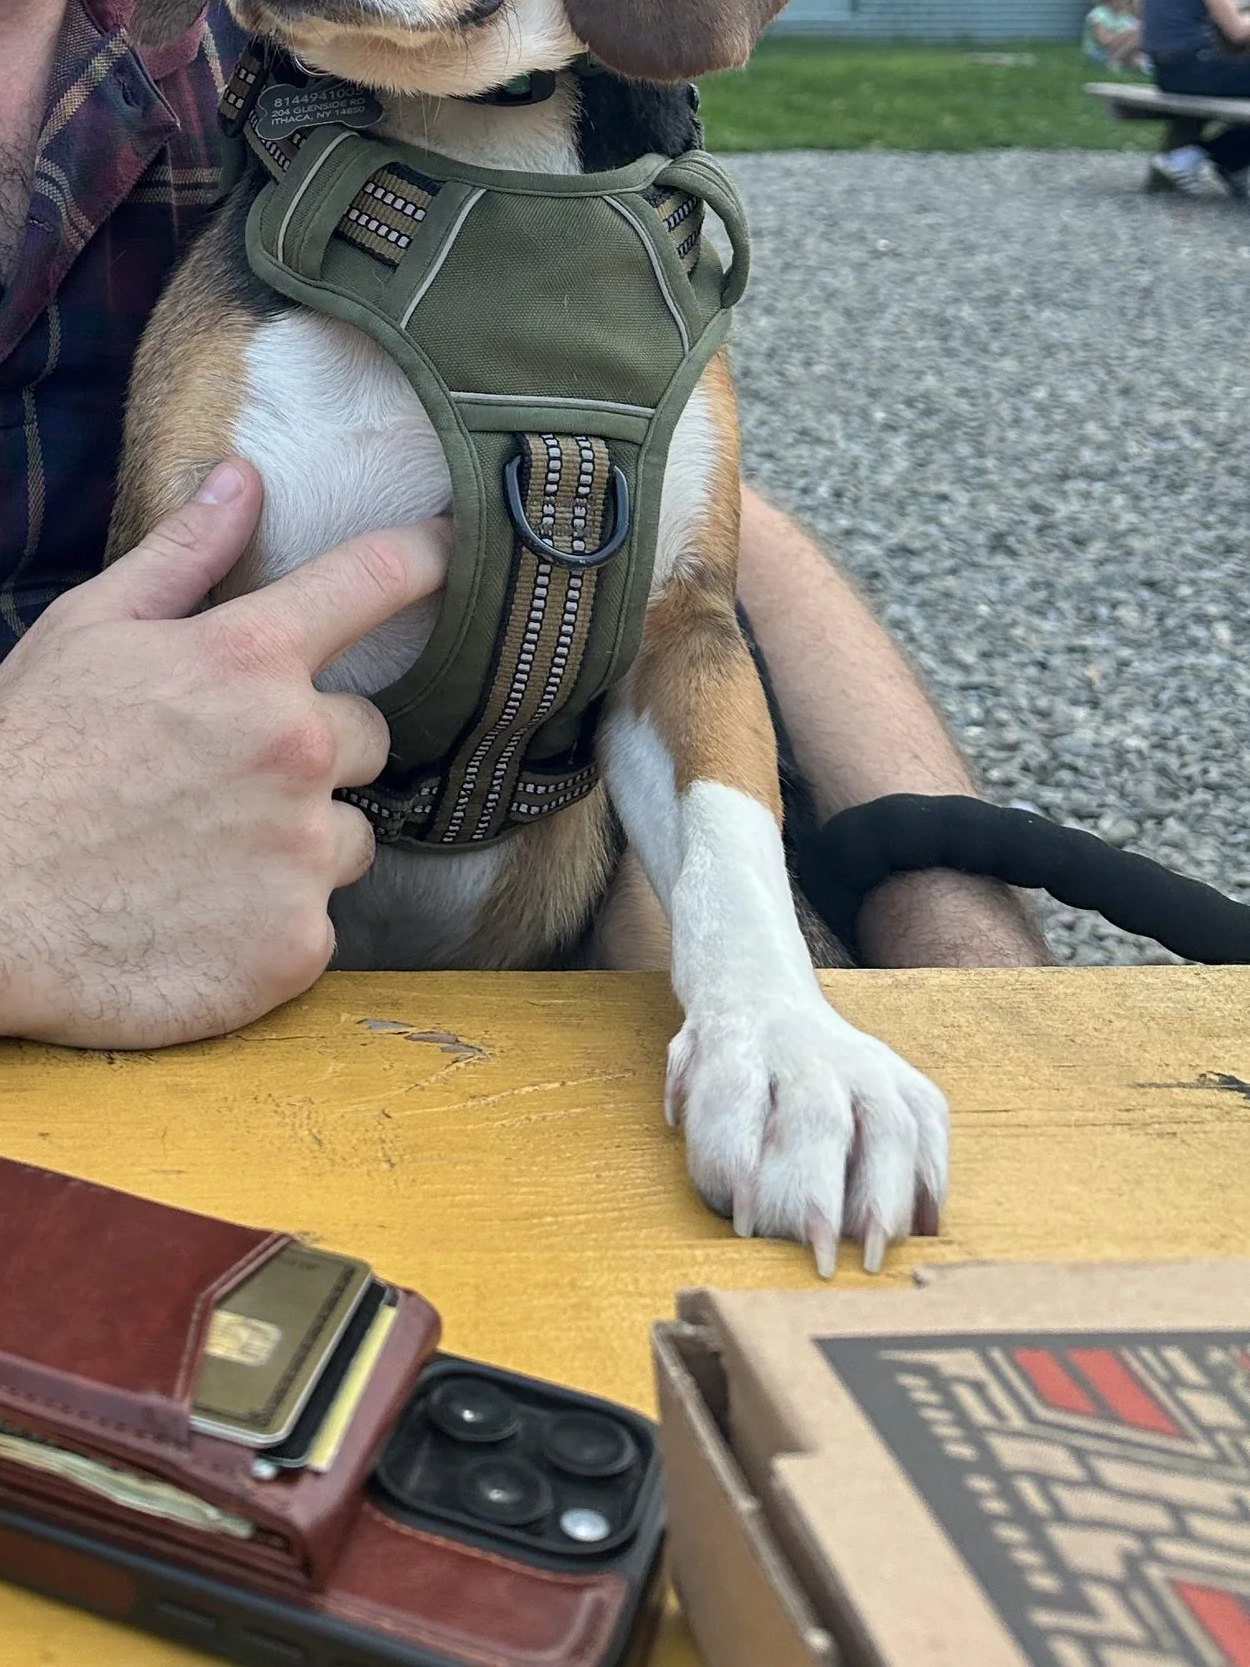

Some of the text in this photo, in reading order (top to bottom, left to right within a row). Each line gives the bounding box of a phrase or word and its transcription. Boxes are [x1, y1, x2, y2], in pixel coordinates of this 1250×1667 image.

[293, 99, 347, 114] GLENSIDE
[271, 114, 314, 126] ITHACA,
[316, 109, 332, 119] NY
